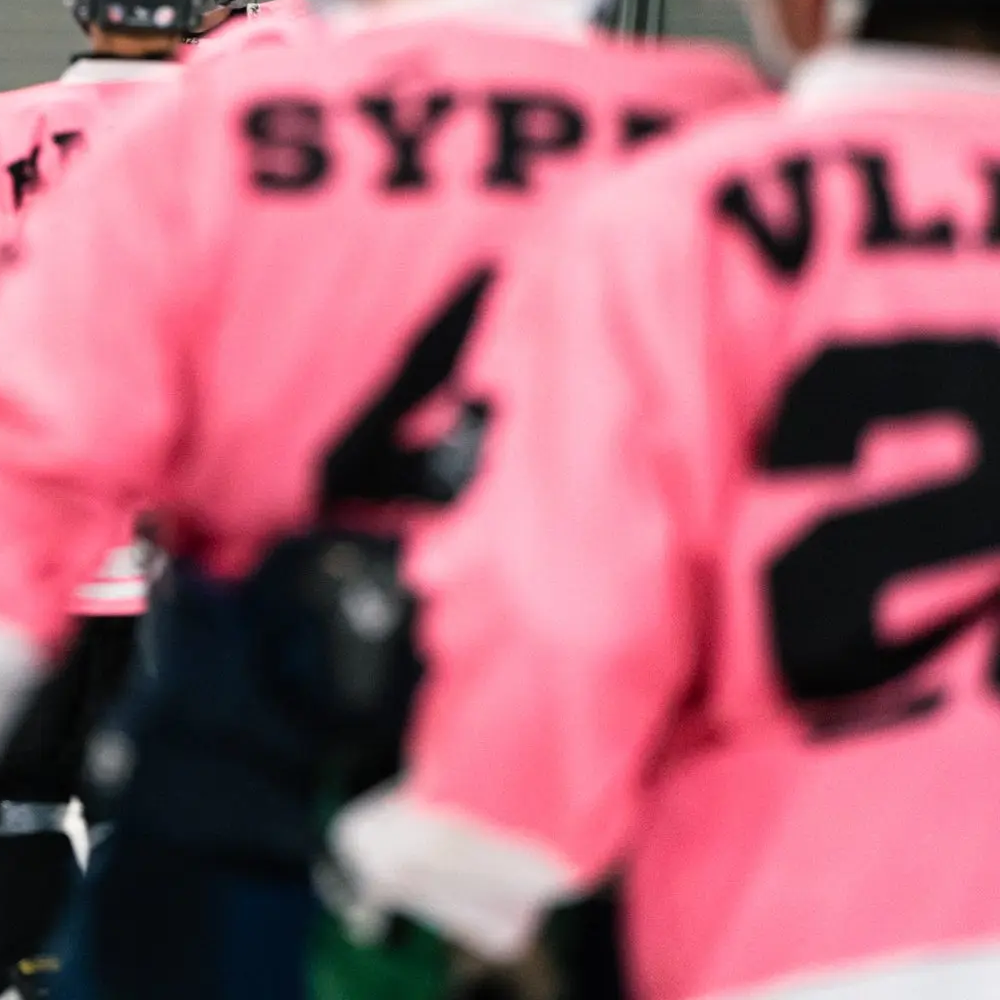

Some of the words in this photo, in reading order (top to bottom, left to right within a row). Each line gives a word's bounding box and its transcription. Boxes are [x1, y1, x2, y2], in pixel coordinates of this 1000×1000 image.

[243, 91, 678, 194] SYP
[714, 150, 1000, 280] VL
[756, 338, 1000, 743] 2
